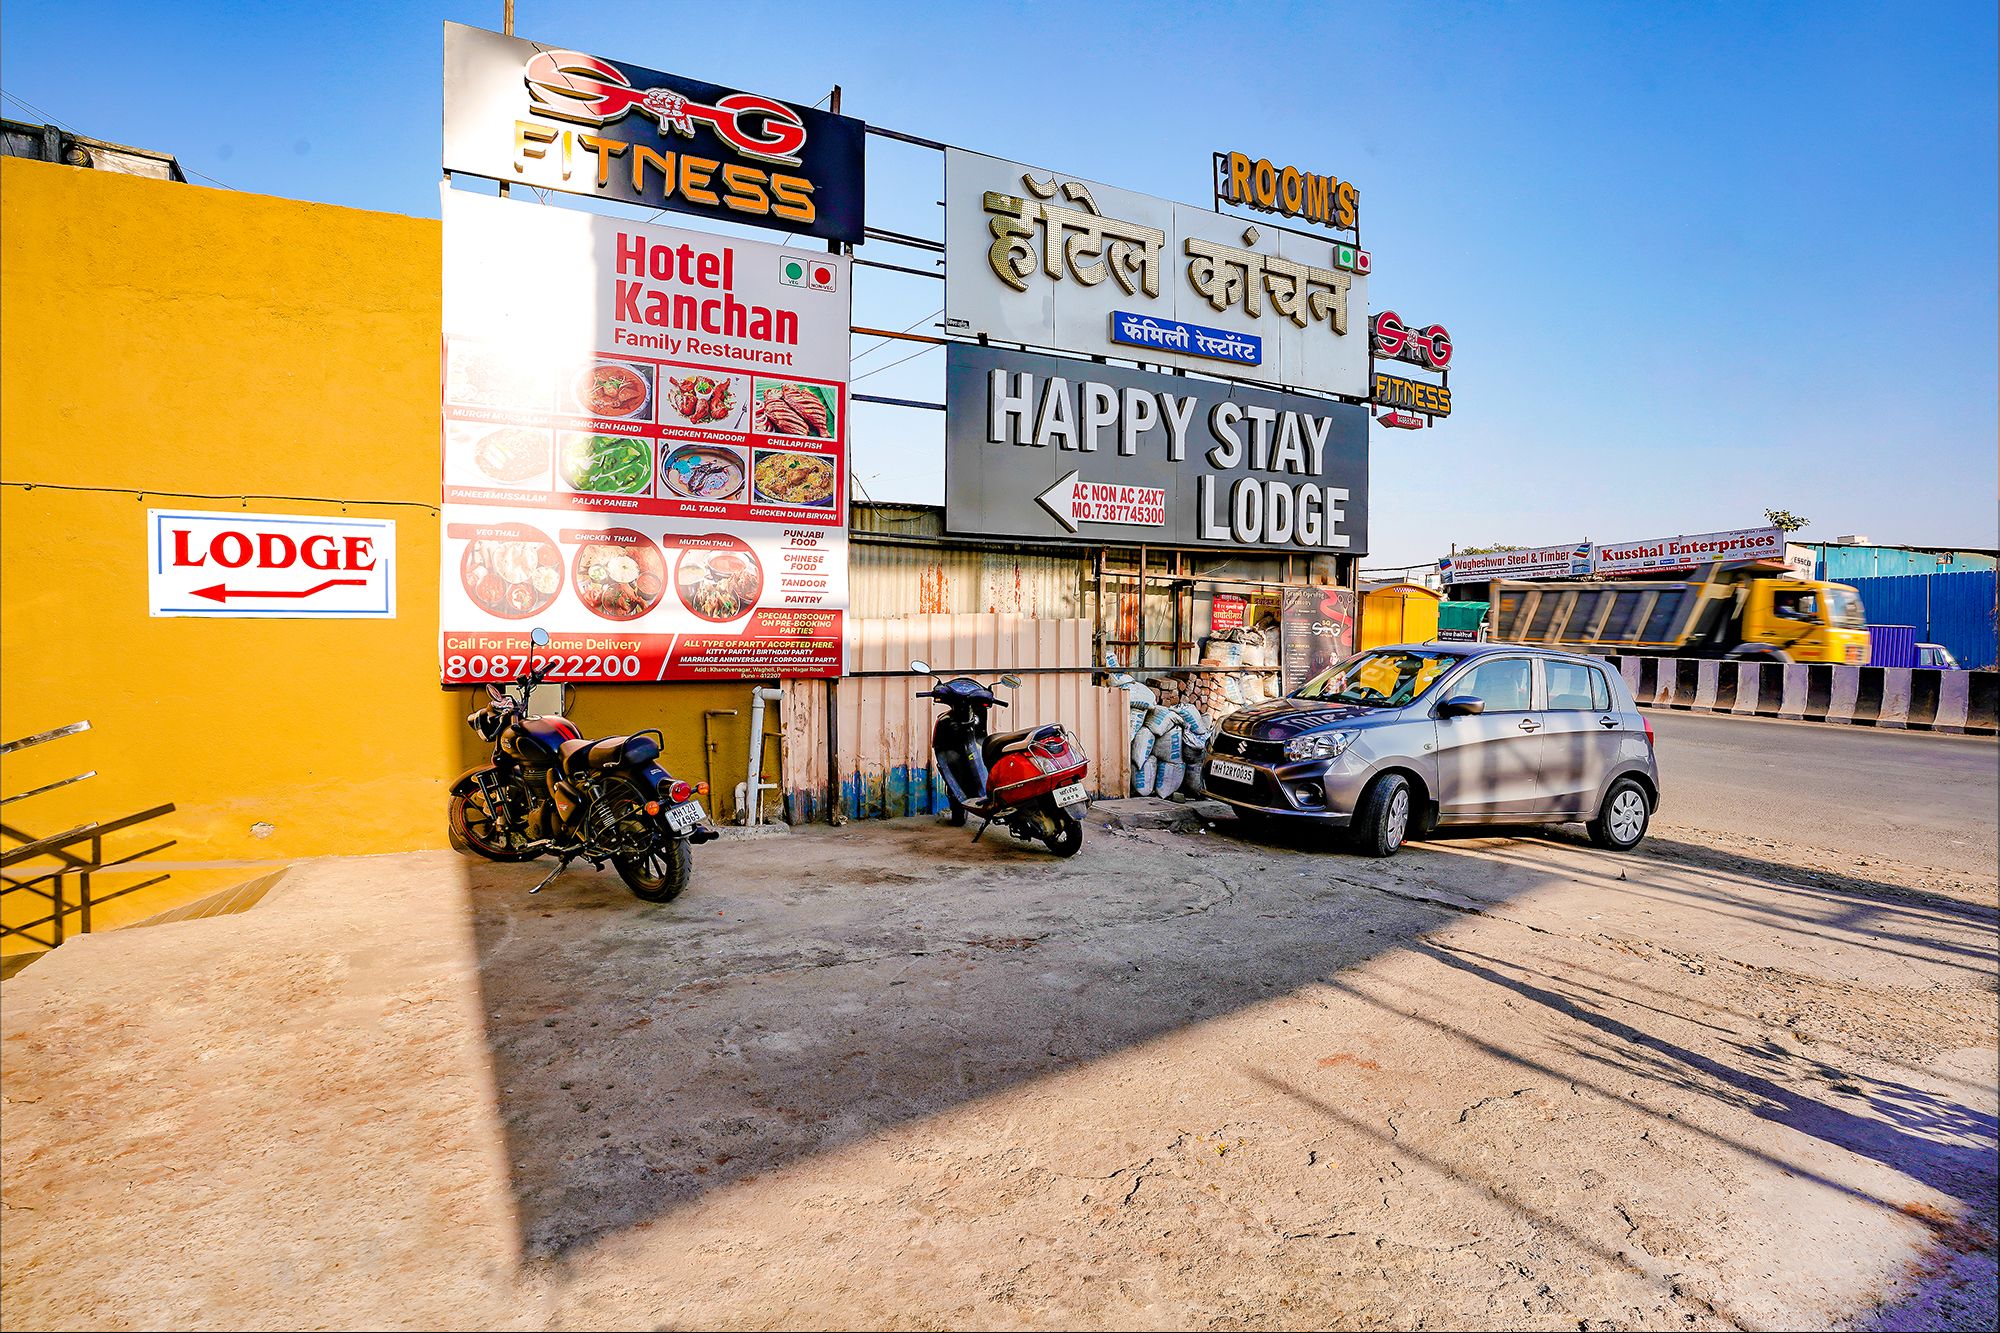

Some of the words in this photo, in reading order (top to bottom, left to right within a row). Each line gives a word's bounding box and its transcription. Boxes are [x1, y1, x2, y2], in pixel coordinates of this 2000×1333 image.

[514, 119, 817, 225] FITNESS
[1225, 150, 1358, 230] ROOM'S
[615, 232, 734, 291] Hotel
[1184, 225, 1353, 337] कांचन
[615, 279, 799, 345] Kanchan
[614, 327, 682, 355] Family
[687, 337, 793, 367] Restaurant
[1376, 375, 1451, 413] FITNESS
[571, 420, 612, 430] CHICKEN
[613, 424, 642, 433] HANDI
[987, 366, 1199, 463] HAPPY
[1207, 400, 1334, 477] STAY
[662, 428, 701, 439] CHICKEN
[702, 432, 746, 443] TANDOORI
[767, 438, 803, 448] CHILLAPI
[804, 441, 823, 450] FISH
[451, 489, 491, 499] PANEER
[1072, 483, 1089, 500] AC
[1091, 485, 1117, 502] NON
[1119, 487, 1135, 504] AC
[1138, 489, 1165, 506] 24X7
[572, 497, 602, 506] PALAK
[603, 500, 639, 509] PANEER
[680, 503, 697, 512] DAL
[698, 505, 727, 514] TADKA
[750, 508, 787, 518] CHICKEN
[787, 511, 806, 519] DUM
[806, 512, 837, 521] BIRYANI
[1199, 472, 1351, 549] LODGE
[476, 528, 494, 536] VEG
[495, 529, 521, 537] THALI
[575, 533, 612, 542] CHICKEN
[613, 534, 637, 543] THALI
[783, 529, 825, 539] PUNJABI
[679, 538, 711, 546] MUTTON
[712, 540, 734, 548] THALI
[790, 538, 818, 547] FOOD
[1602, 543, 1664, 561] Kusshal
[1668, 534, 1775, 556] Enterprises
[172, 529, 377, 571] LODGE
[783, 554, 825, 564] CHINESE
[1454, 556, 1505, 571] Wagheshwar
[1507, 553, 1529, 566] Steel
[1531, 552, 1538, 563] &
[1539, 550, 1570, 562] Timber
[790, 562, 817, 571] FOOD
[782, 578, 827, 588] TANDOOR
[785, 595, 823, 604] PANTRY
[757, 612, 793, 620] SPECIAL
[793, 613, 836, 621] DISCOUNT
[777, 620, 832, 628] PRE-BOOKING
[779, 627, 814, 635] PARTIES
[447, 638, 475, 650] Call
[479, 638, 502, 650] For
[586, 638, 641, 652] Delivery
[684, 640, 701, 648] ALL
[702, 640, 725, 648] TYPE
[725, 640, 738, 648] OF
